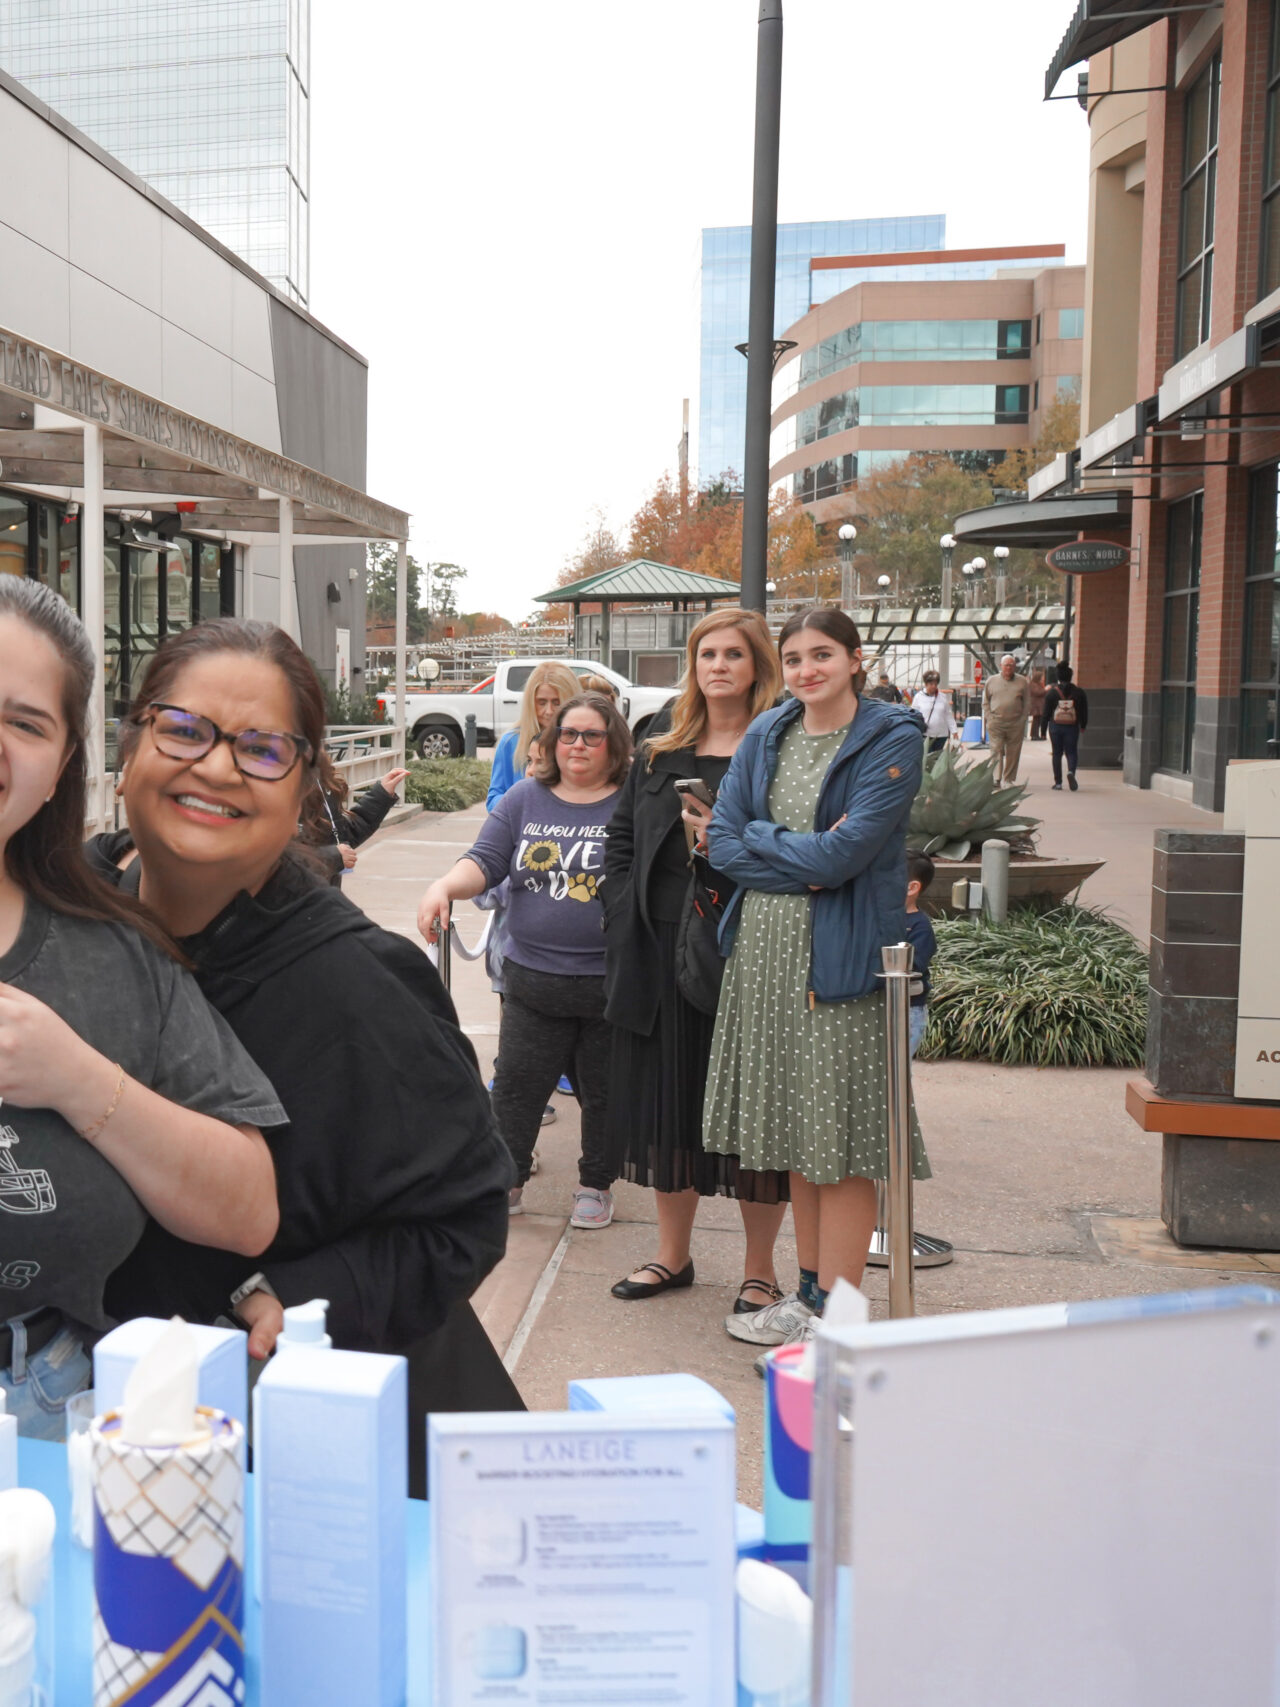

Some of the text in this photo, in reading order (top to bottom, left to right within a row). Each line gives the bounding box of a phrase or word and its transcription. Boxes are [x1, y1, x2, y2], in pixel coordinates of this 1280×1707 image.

[60, 360, 113, 423] FRIES
[120, 388, 174, 448] SHAKES
[179, 414, 206, 463] HOT
[208, 428, 240, 474] DOGS
[1055, 551, 1088, 561] BARNES
[1096, 549, 1123, 560] NOBLE
[516, 839, 603, 872] LOVE
[523, 1440, 638, 1462] LANEIGE
